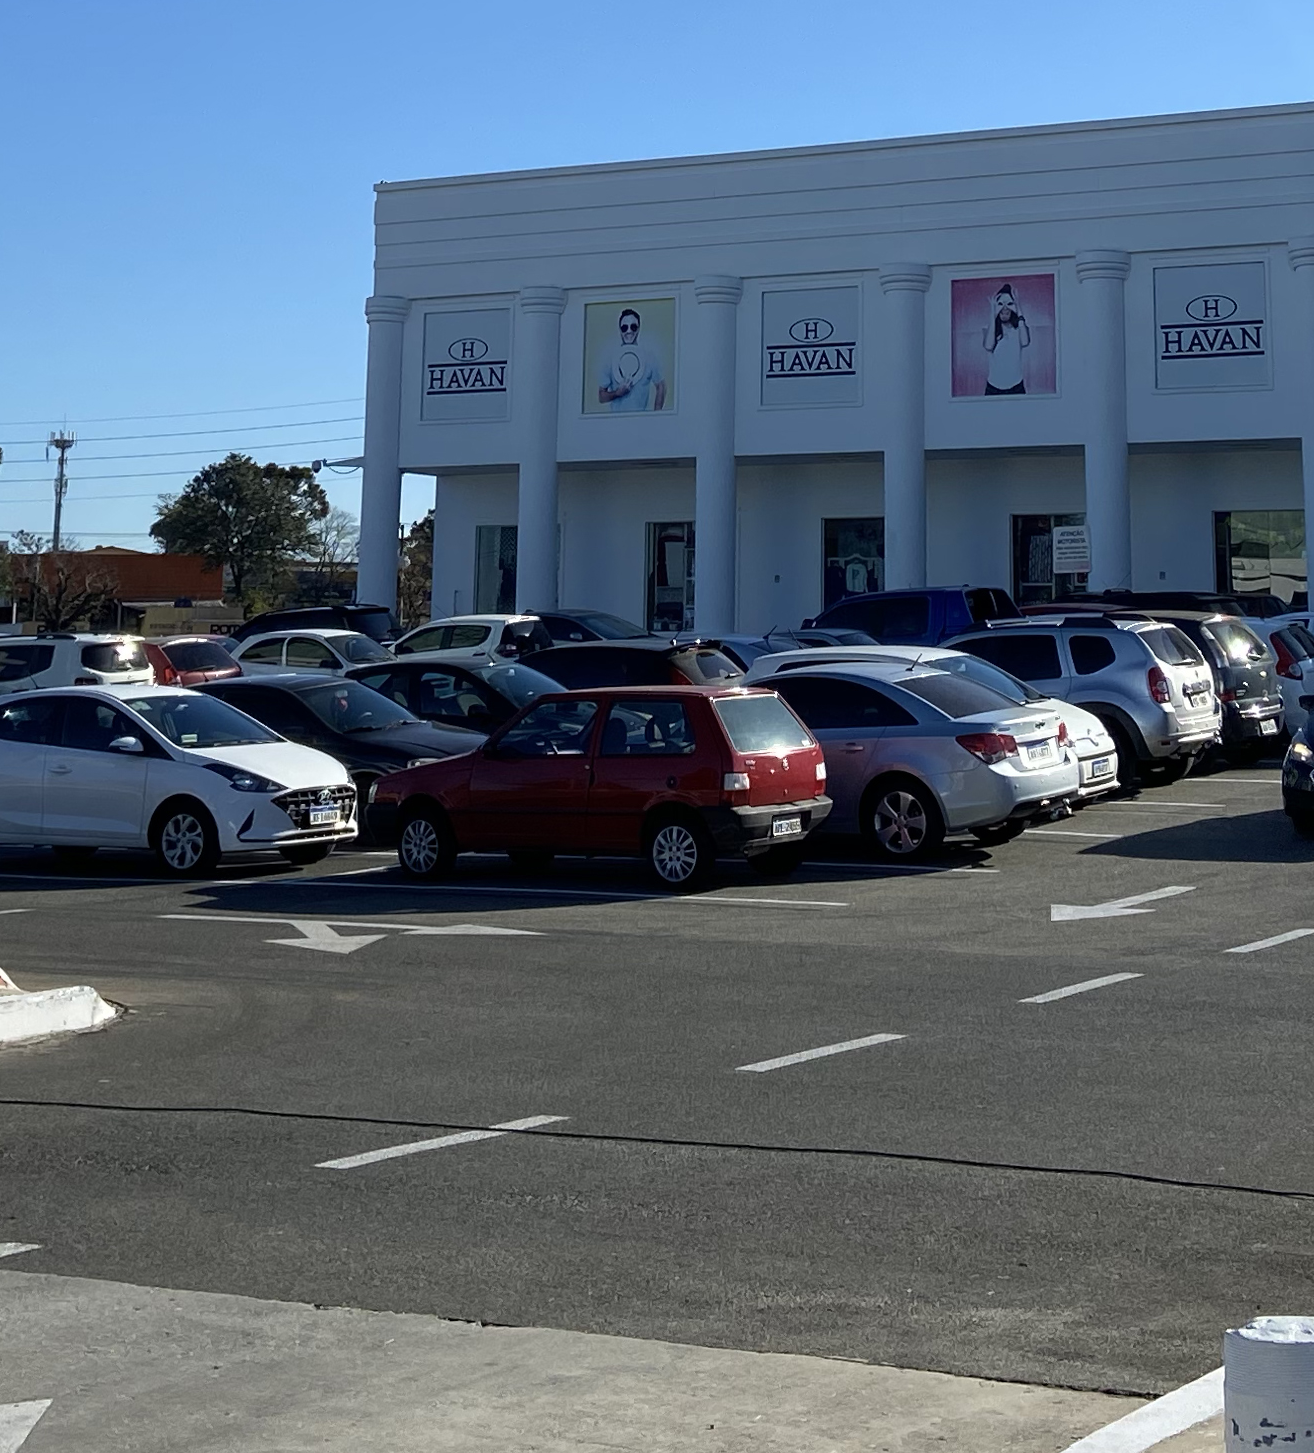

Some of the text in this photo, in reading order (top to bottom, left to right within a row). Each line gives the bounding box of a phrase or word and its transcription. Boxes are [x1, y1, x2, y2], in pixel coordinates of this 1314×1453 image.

[1202, 298, 1220, 318] H
[803, 321, 819, 339] H
[1162, 327, 1262, 353] HAVAN
[461, 341, 476, 358] H
[767, 347, 855, 372] HAVAN
[427, 365, 506, 389] HAVAN
